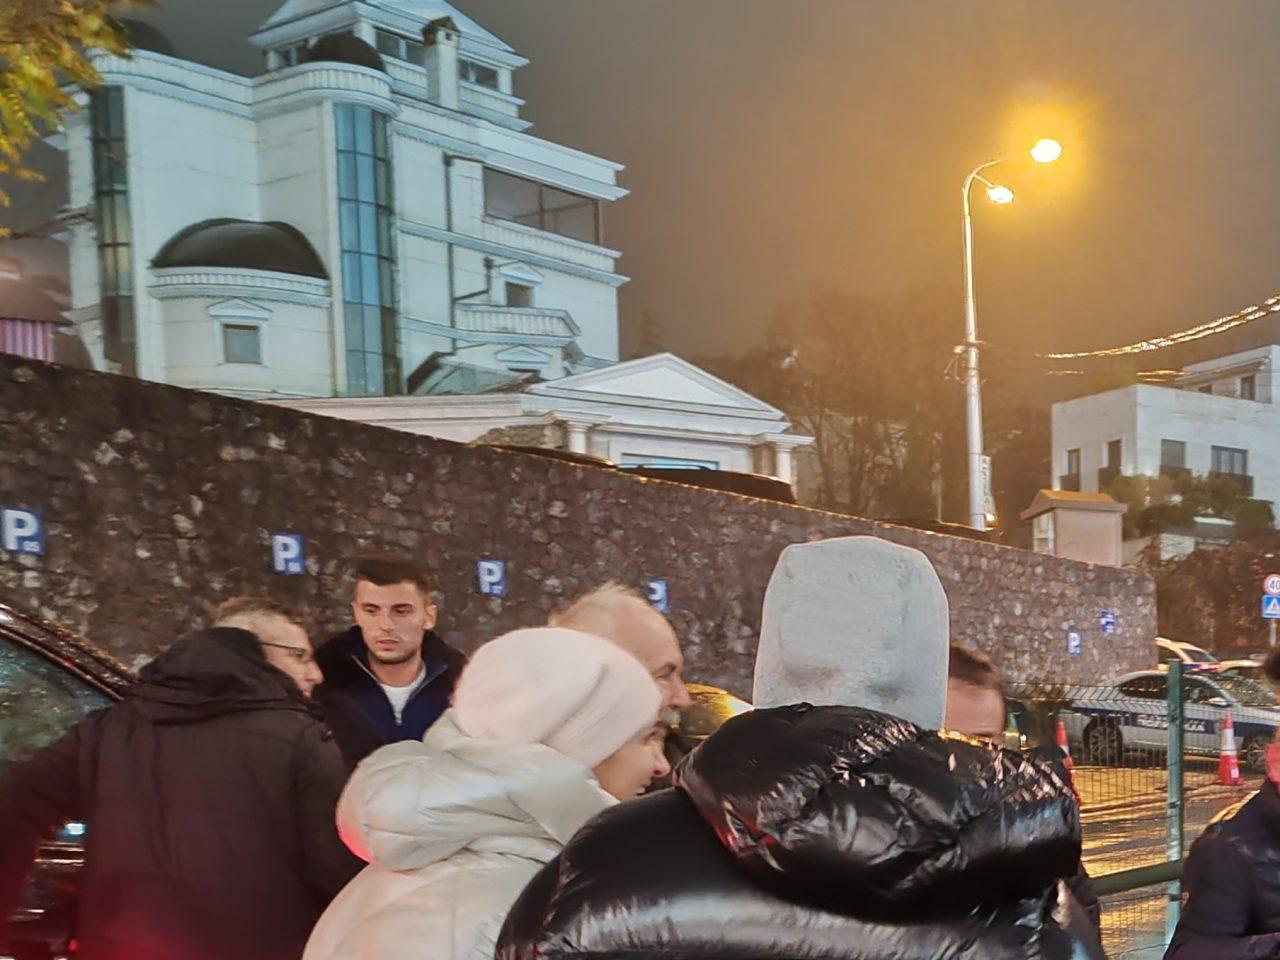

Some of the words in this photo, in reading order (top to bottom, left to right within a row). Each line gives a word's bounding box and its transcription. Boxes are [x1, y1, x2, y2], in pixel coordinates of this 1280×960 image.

[5, 509, 38, 550] P
[273, 535, 300, 571] P
[479, 561, 501, 593] P
